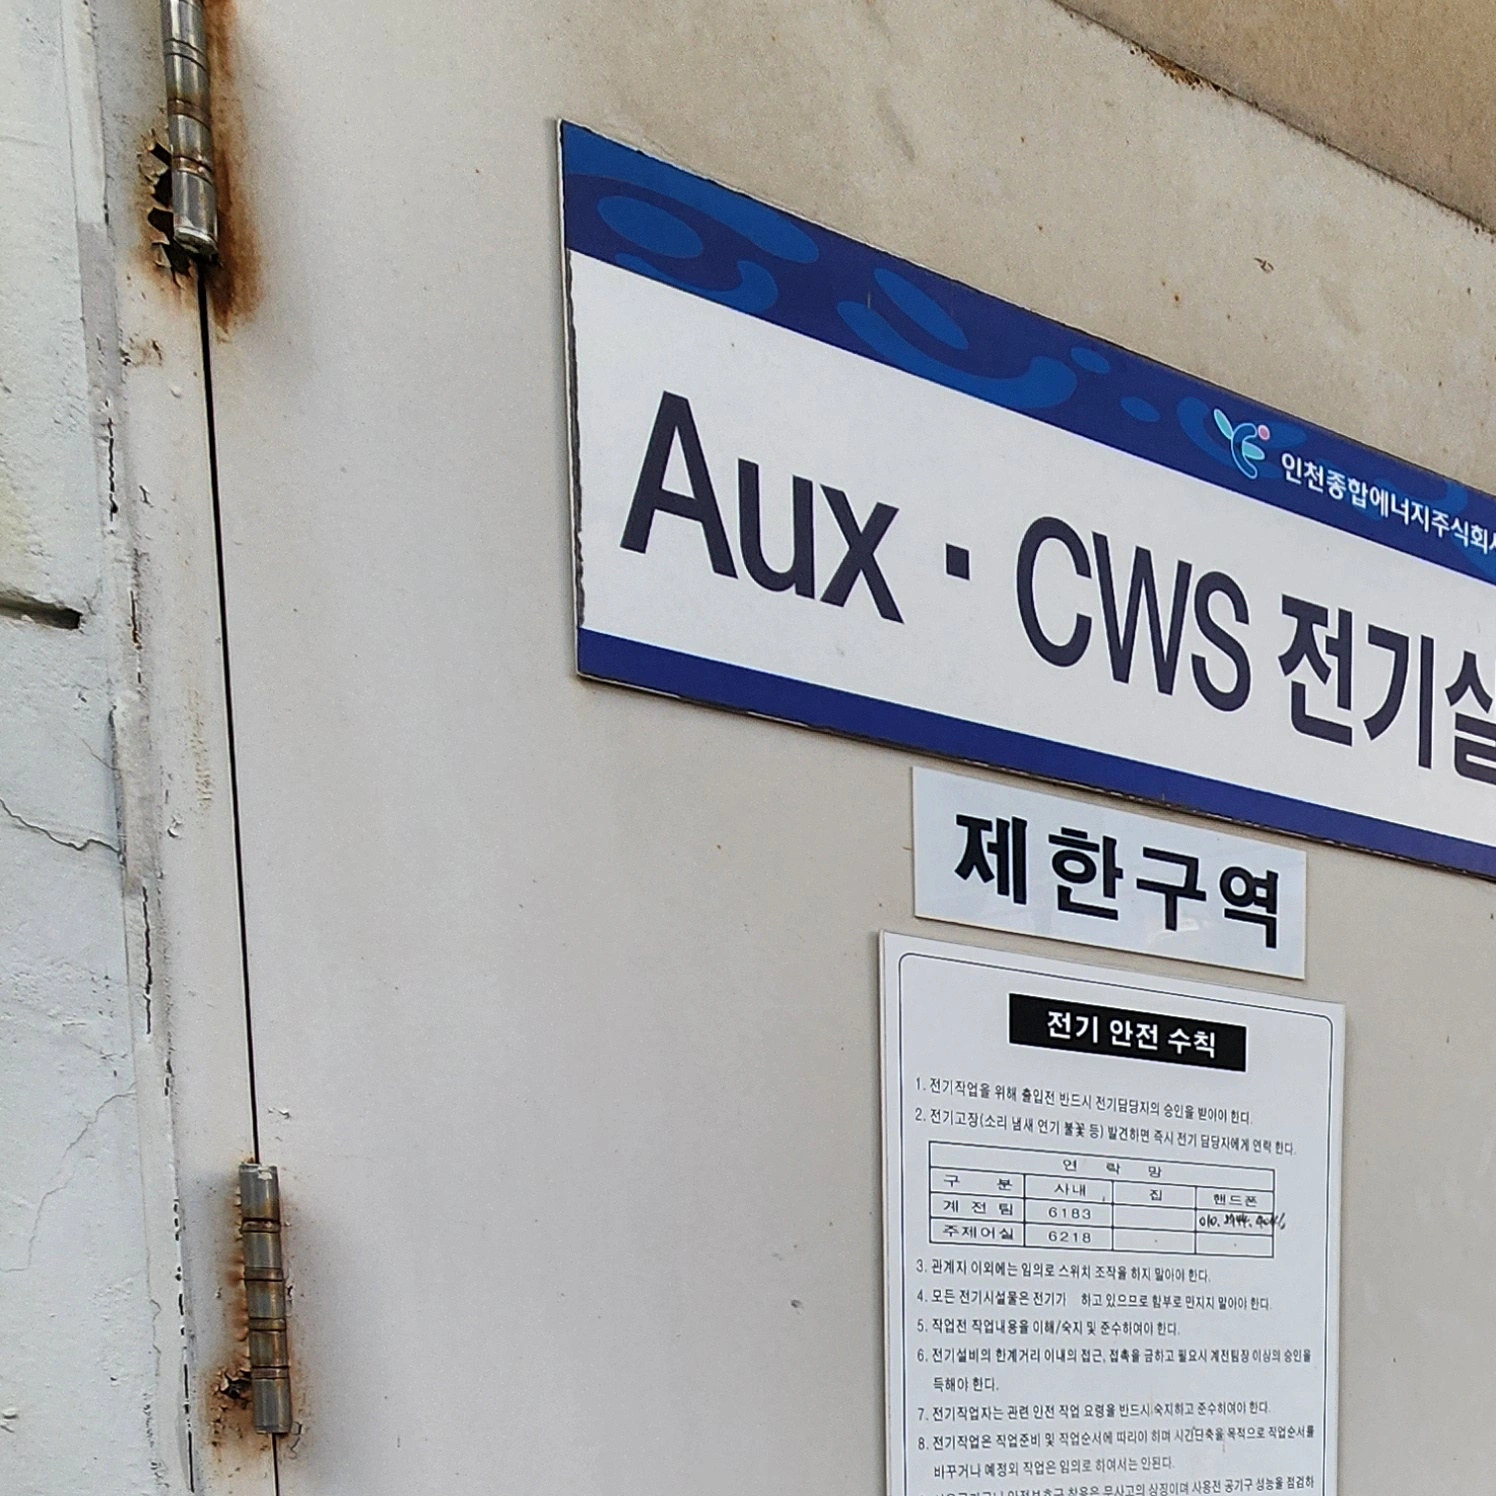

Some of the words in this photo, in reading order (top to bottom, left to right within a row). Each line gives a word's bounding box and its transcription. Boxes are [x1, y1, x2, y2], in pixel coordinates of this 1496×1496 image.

[620, 391, 904, 624] Aux
[1015, 516, 1251, 712] CWS
[954, 814, 1279, 948] 제한구역
[1047, 1011, 1098, 1044] 전기
[1109, 1020, 1158, 1050] 안전
[1168, 1028, 1215, 1059] 수칙
[916, 1077, 926, 1091] 1.
[930, 1078, 990, 1099] 전기작업을
[995, 1085, 1017, 1102] 위해
[1022, 1088, 1055, 1106] 출입전
[1059, 1092, 1091, 1110] 반드시
[1164, 1103, 1194, 1120] 승인을
[915, 1107, 926, 1122] 2.
[930, 1108, 1007, 1130] 전기고장(소리
[1012, 1116, 1033, 1133] 냄새
[1038, 1119, 1059, 1135] 연기
[1064, 1121, 1085, 1138] 불꽃
[1089, 1124, 1103, 1139] 등)
[1108, 1126, 1149, 1143] 발견하면
[1154, 1129, 1173, 1145] 즉시
[1177, 1132, 1197, 1148] 전기
[1054, 1183, 1086, 1197] 사내
[1149, 1189, 1162, 1201] 집
[1049, 1207, 1091, 1220] 6183
[942, 1224, 1014, 1240] 주제어실
[1048, 1231, 1091, 1243] 6218
[916, 1259, 927, 1272] 3.
[931, 1259, 967, 1275] 관계자
[971, 1260, 1018, 1277] 이외에는
[1021, 1262, 1055, 1278] 임의로
[1059, 1264, 1090, 1279] 스위치
[1095, 1266, 1127, 1280] 조작을
[1131, 1266, 1151, 1281] 하지
[917, 1289, 928, 1302] 4.
[931, 1289, 955, 1304] 모든
[959, 1289, 1030, 1306] 전기시설물은
[1033, 1291, 1066, 1307] 전기가
[1081, 1293, 1102, 1307] 하고
[1106, 1293, 1149, 1308] 있으므로
[1152, 1294, 1182, 1308] 함부로
[917, 1319, 928, 1332] 5.
[932, 1318, 967, 1334] 작업전
[972, 1319, 1029, 1334] 작업내용을
[1033, 1320, 1082, 1335] 이해/숙지
[1087, 1321, 1096, 1336] 및
[1100, 1321, 1153, 1336] 준수하여야
[917, 1348, 928, 1362] 6.
[932, 1347, 991, 1363] 전기설비의
[996, 1348, 1040, 1363] 한계거리
[1044, 1348, 1077, 1363] 이내의
[1109, 1348, 1140, 1363] 접촉을
[1144, 1349, 1174, 1363] 금하고
[1178, 1349, 1207, 1363] 필요시
[1284, 1349, 1311, 1363] 승인을
[933, 1377, 968, 1392] 득해야
[918, 1408, 929, 1421] 7.
[933, 1406, 1004, 1422] 전기작업자는
[1007, 1405, 1029, 1420] 관련
[1059, 1404, 1079, 1419] 작업
[1084, 1403, 1115, 1418] 요령을
[1119, 1403, 1152, 1417] 반드시
[1153, 1401, 1194, 1416] 숙지하고
[918, 1437, 929, 1450] 8.
[933, 1434, 992, 1451] 전기작업은
[996, 1433, 1040, 1448] 작업준비
[1045, 1433, 1054, 1447] 및
[1059, 1431, 1112, 1446] 작업순서에
[1227, 1427, 1265, 1440] 목적으로
[1268, 1425, 1314, 1439] 작업순서를
[934, 1463, 981, 1480] 바꾸거나
[985, 1462, 1018, 1477] 예정외
[1023, 1460, 1056, 1475] 작업은
[1060, 1459, 1092, 1474] 임의로
[1096, 1457, 1138, 1473] 하여서는
[1149, 1482, 1189, 1496] 상징이며
[1192, 1480, 1221, 1494] 사용전
[1225, 1478, 1253, 1493] 공기구
[1256, 1476, 1283, 1491] 성능을
[1287, 1475, 1314, 1489] 점검하
